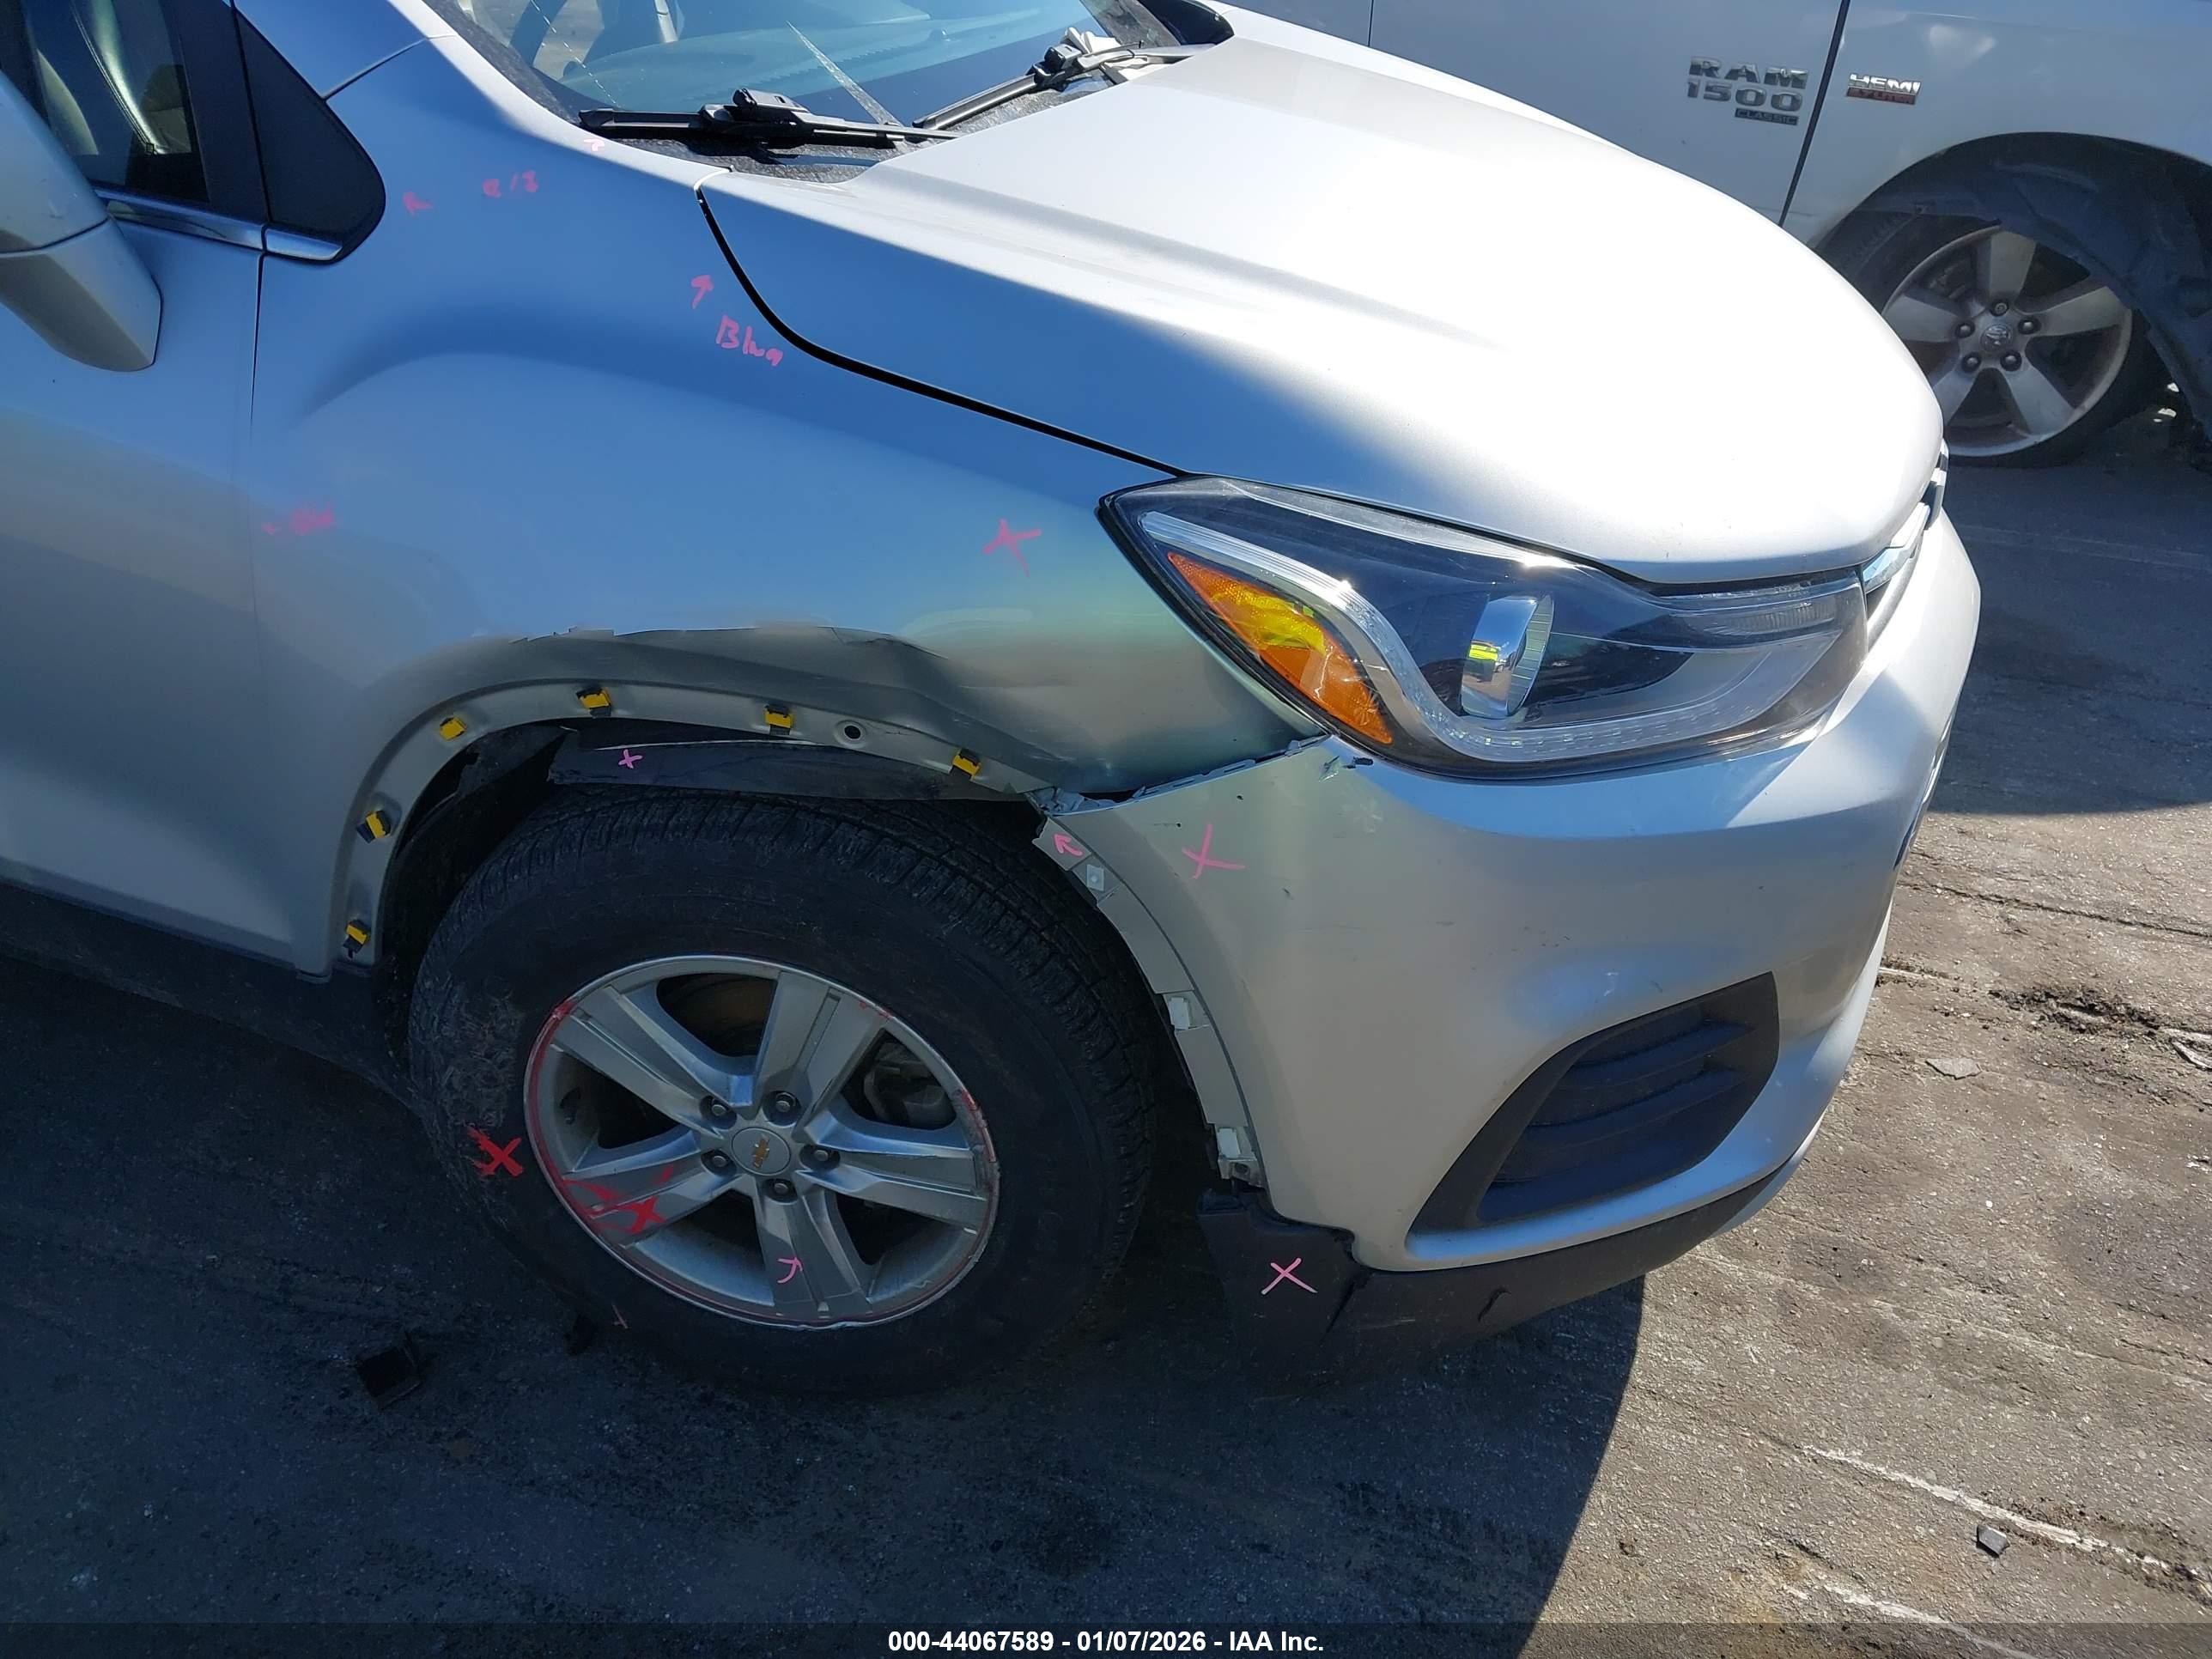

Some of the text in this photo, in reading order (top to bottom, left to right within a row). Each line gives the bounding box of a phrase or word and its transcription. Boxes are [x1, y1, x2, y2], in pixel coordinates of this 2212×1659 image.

[1688, 56, 1808, 89] RAM
[1849, 74, 1922, 95] HEMI
[1686, 79, 1803, 112] 1500
[1735, 107, 1800, 125] CLASSIC
